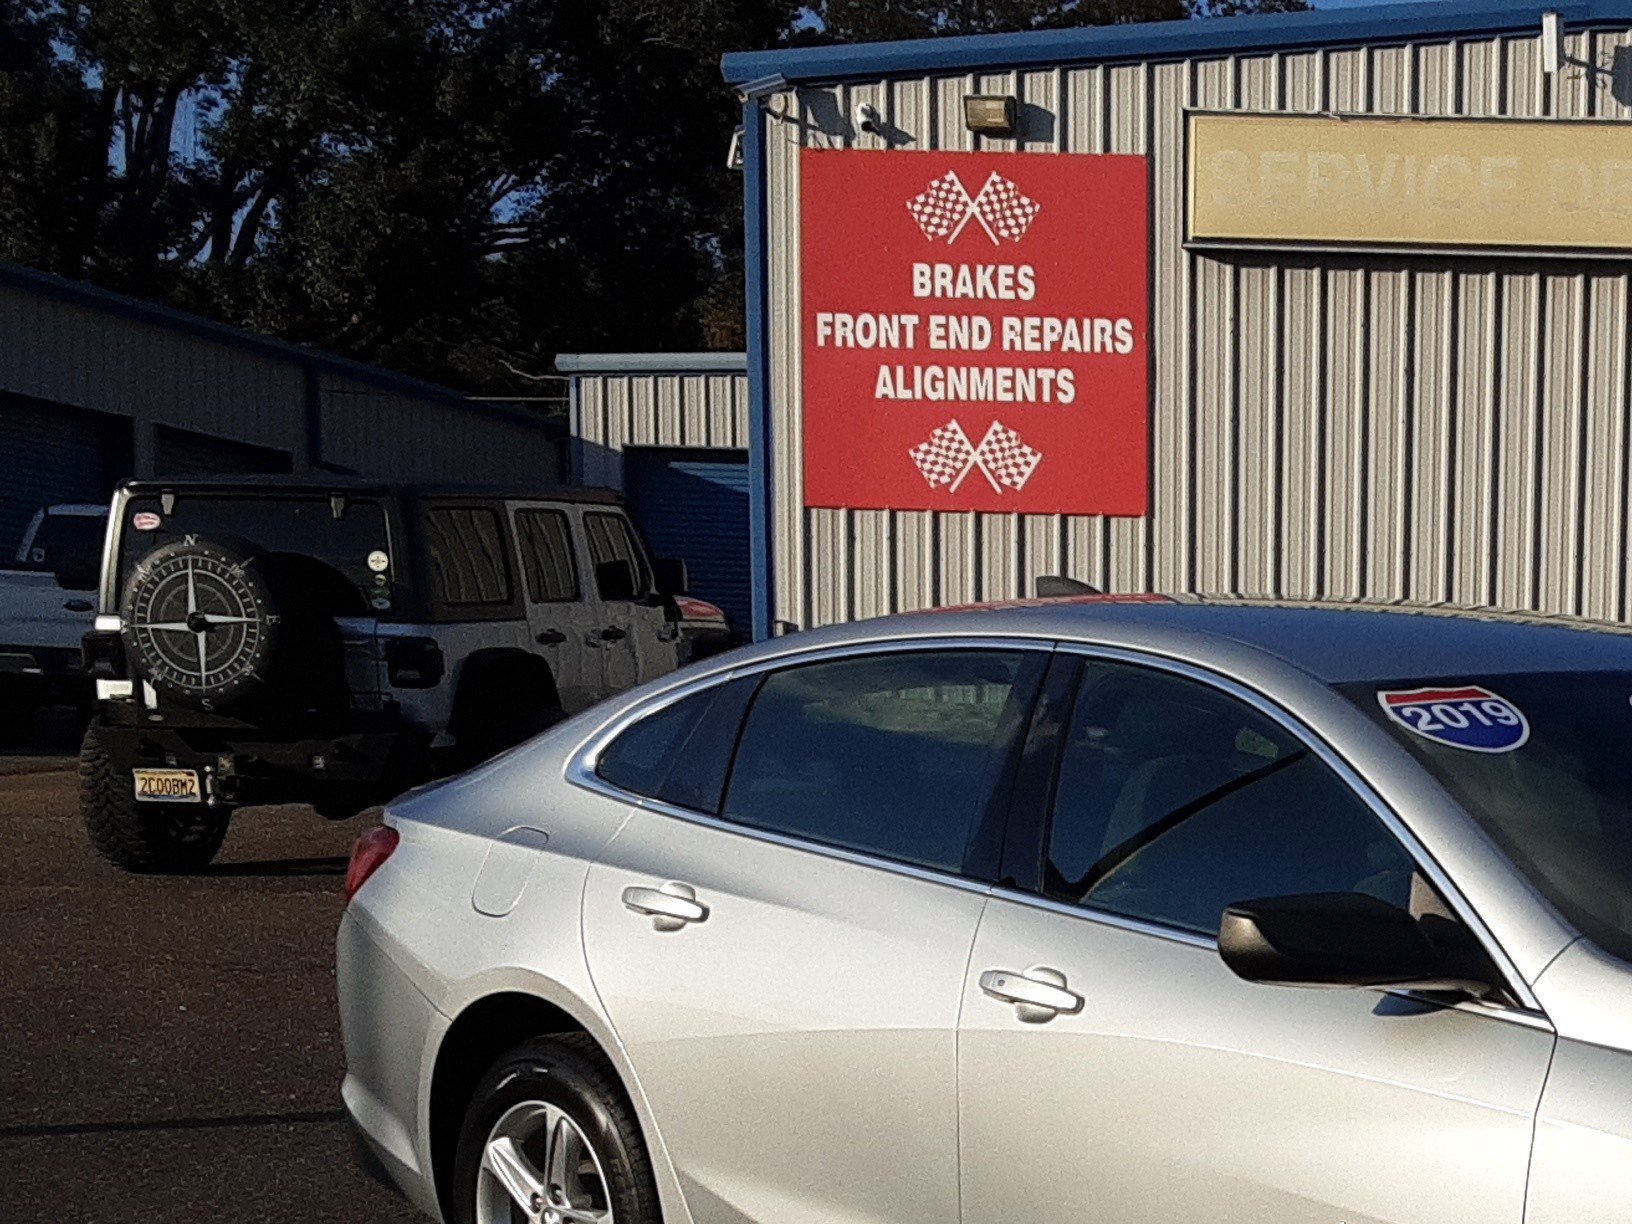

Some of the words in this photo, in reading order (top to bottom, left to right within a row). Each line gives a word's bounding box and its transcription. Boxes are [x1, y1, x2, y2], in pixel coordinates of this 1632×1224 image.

[913, 262, 1036, 301] BRAKES
[816, 312, 919, 349] FRONT
[928, 314, 992, 351] END
[1002, 316, 1134, 355] REPAIRS
[875, 364, 1076, 404] ALIGNMENTS
[1401, 701, 1519, 731] 2019
